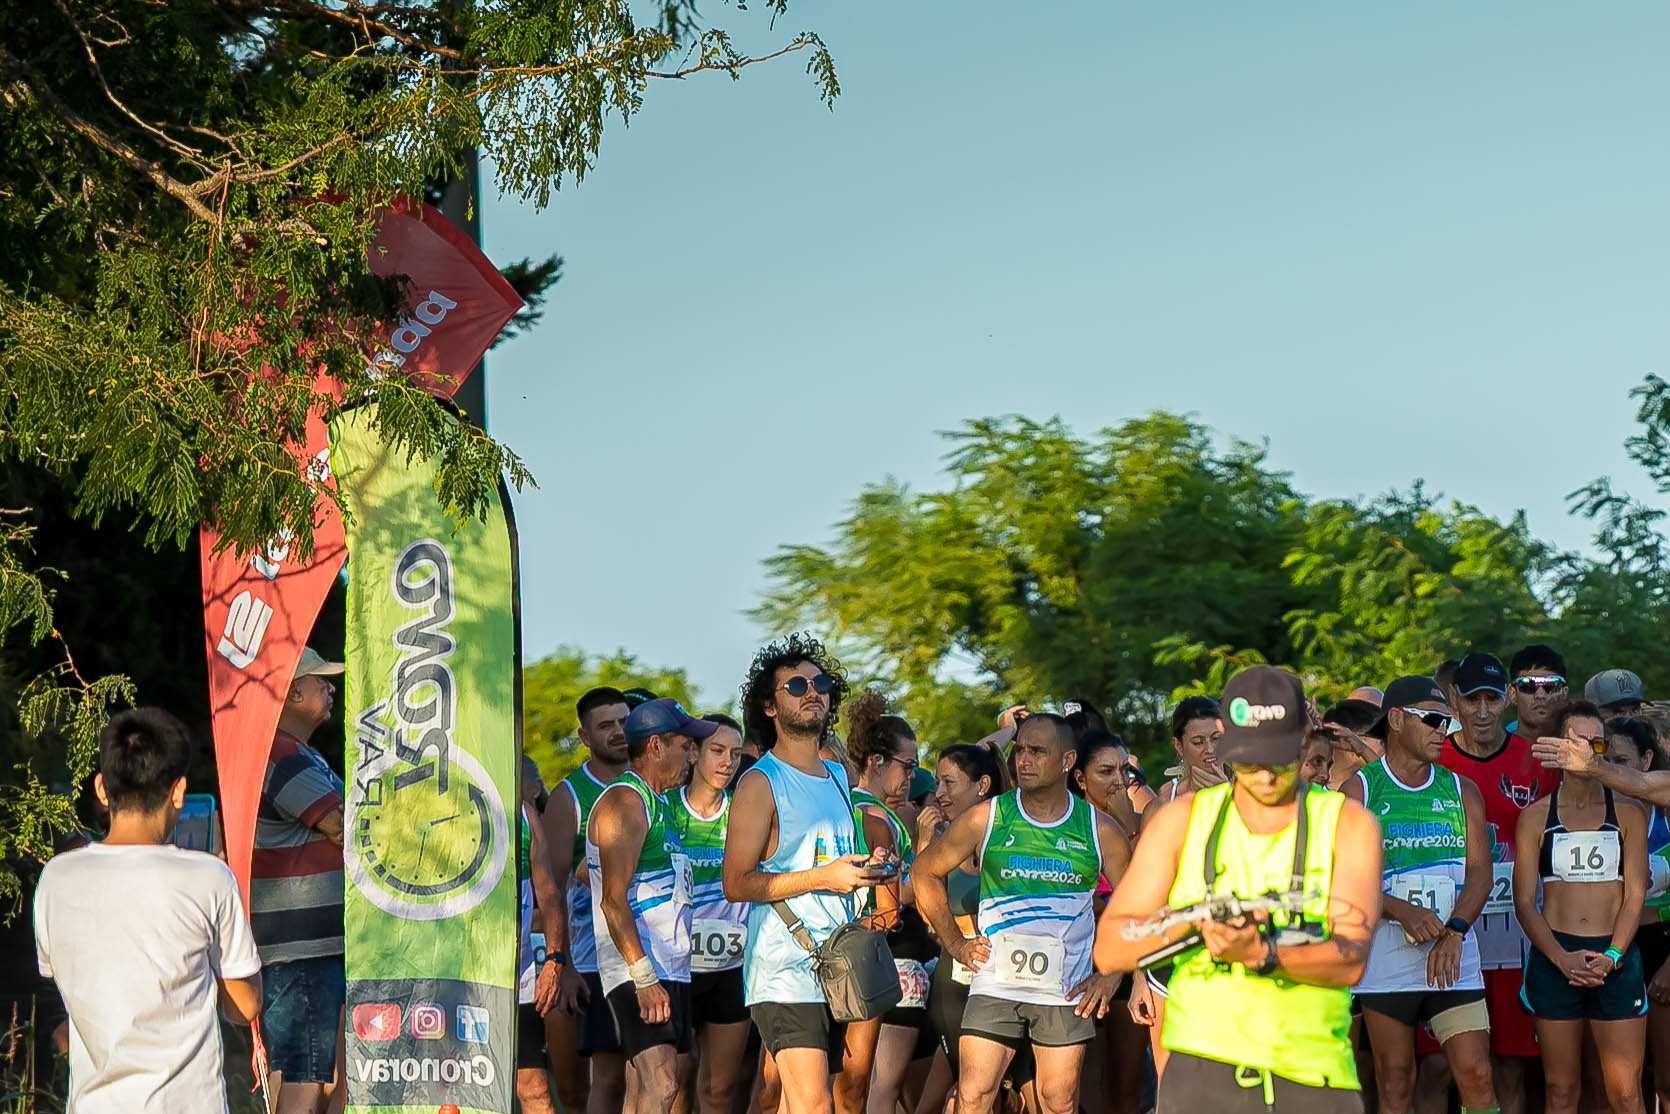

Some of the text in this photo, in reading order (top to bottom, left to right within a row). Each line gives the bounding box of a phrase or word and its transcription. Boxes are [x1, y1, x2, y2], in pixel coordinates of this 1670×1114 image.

[1387, 822, 1453, 837] FIGHIERA
[1008, 855, 1074, 873] FIGHIERA
[1570, 846, 1605, 871] 16
[1407, 889, 1440, 914] 51
[1489, 877, 1513, 901] 2
[691, 932, 743, 957] 103
[1010, 949, 1049, 976] 90
